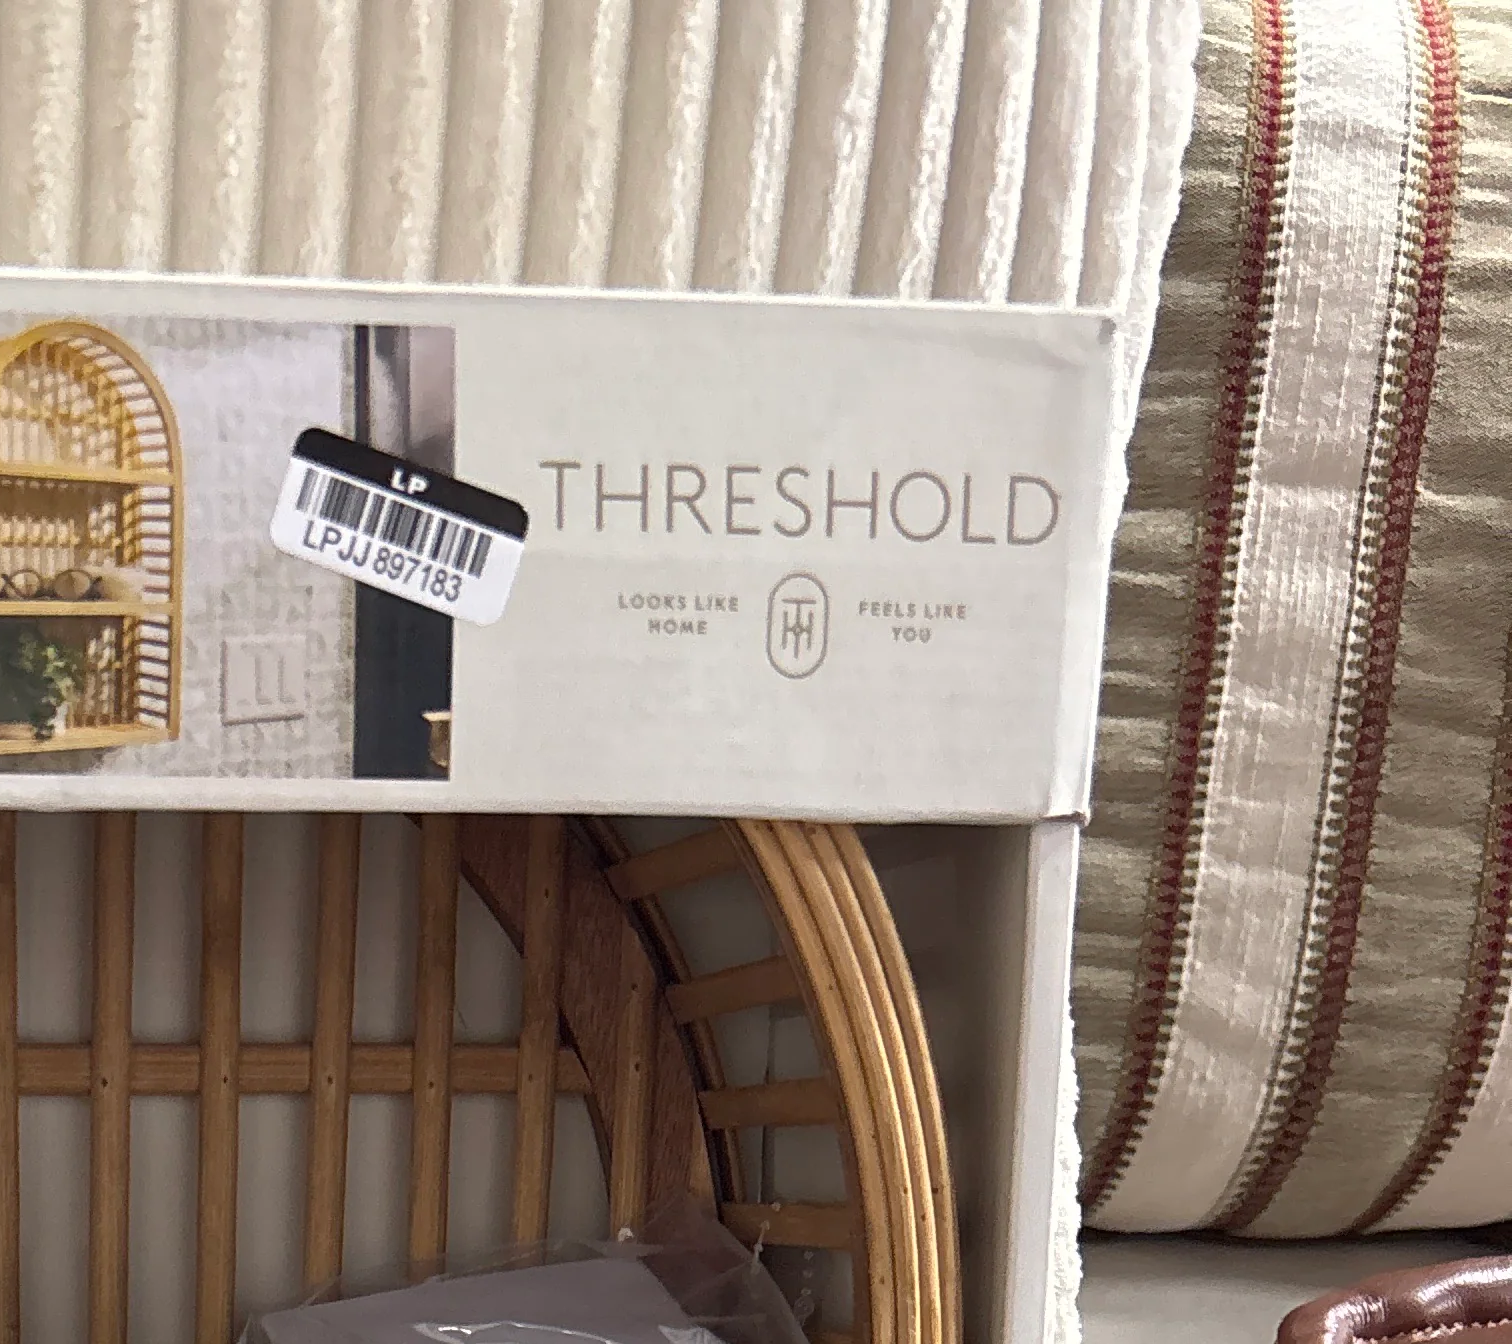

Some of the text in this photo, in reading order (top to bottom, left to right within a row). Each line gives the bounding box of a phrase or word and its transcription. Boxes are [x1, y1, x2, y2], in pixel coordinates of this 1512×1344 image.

[388, 468, 430, 496] LP
[539, 460, 1062, 546] THRESHOLD
[617, 592, 739, 614] LOOKS LIKE
[858, 599, 967, 621] FEELS LIKE
[647, 617, 708, 636] HOME
[891, 625, 932, 644] YOU
